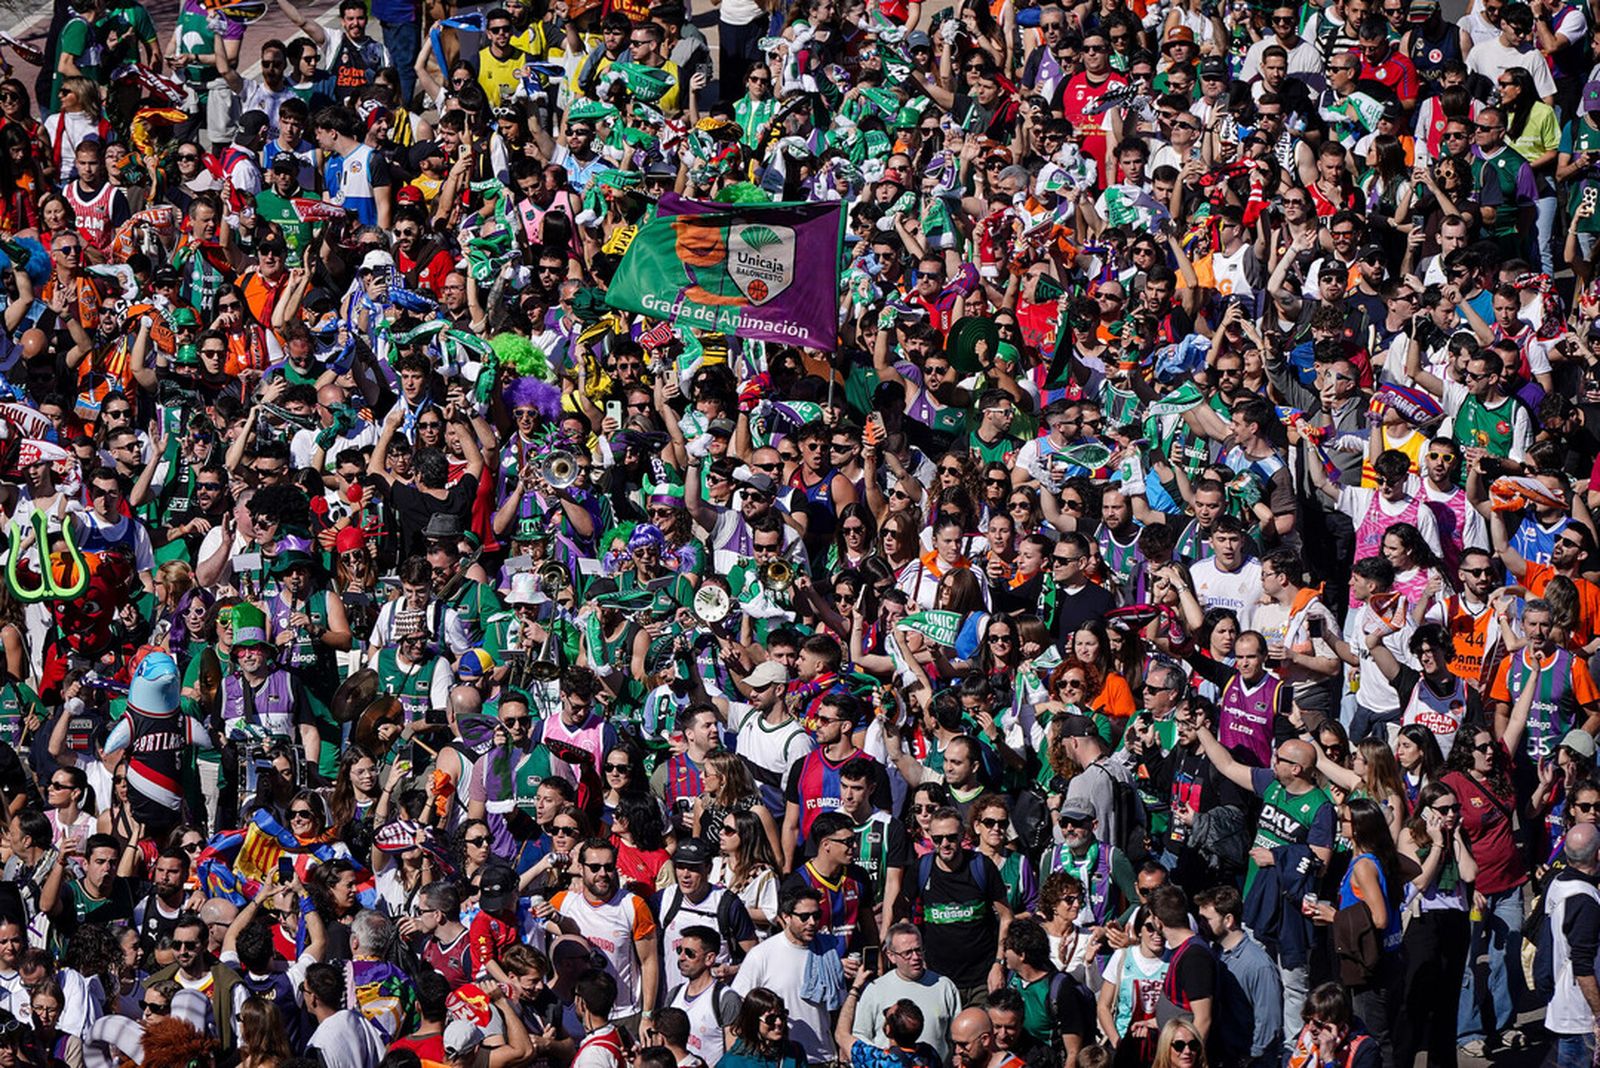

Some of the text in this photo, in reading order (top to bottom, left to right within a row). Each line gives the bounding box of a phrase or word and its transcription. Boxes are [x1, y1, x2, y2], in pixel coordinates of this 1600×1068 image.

[76, 216, 104, 231] CAM
[738, 252, 785, 274] Unicaja
[736, 266, 784, 284] BALONCESTO
[641, 294, 809, 344] Grada de Animación
[1206, 596, 1245, 610] mirates
[1465, 632, 1485, 647] 44
[1421, 713, 1454, 726] UCAM
[1526, 736, 1551, 756] 55
[807, 799, 817, 810] FC
[1261, 804, 1299, 834] DKV
